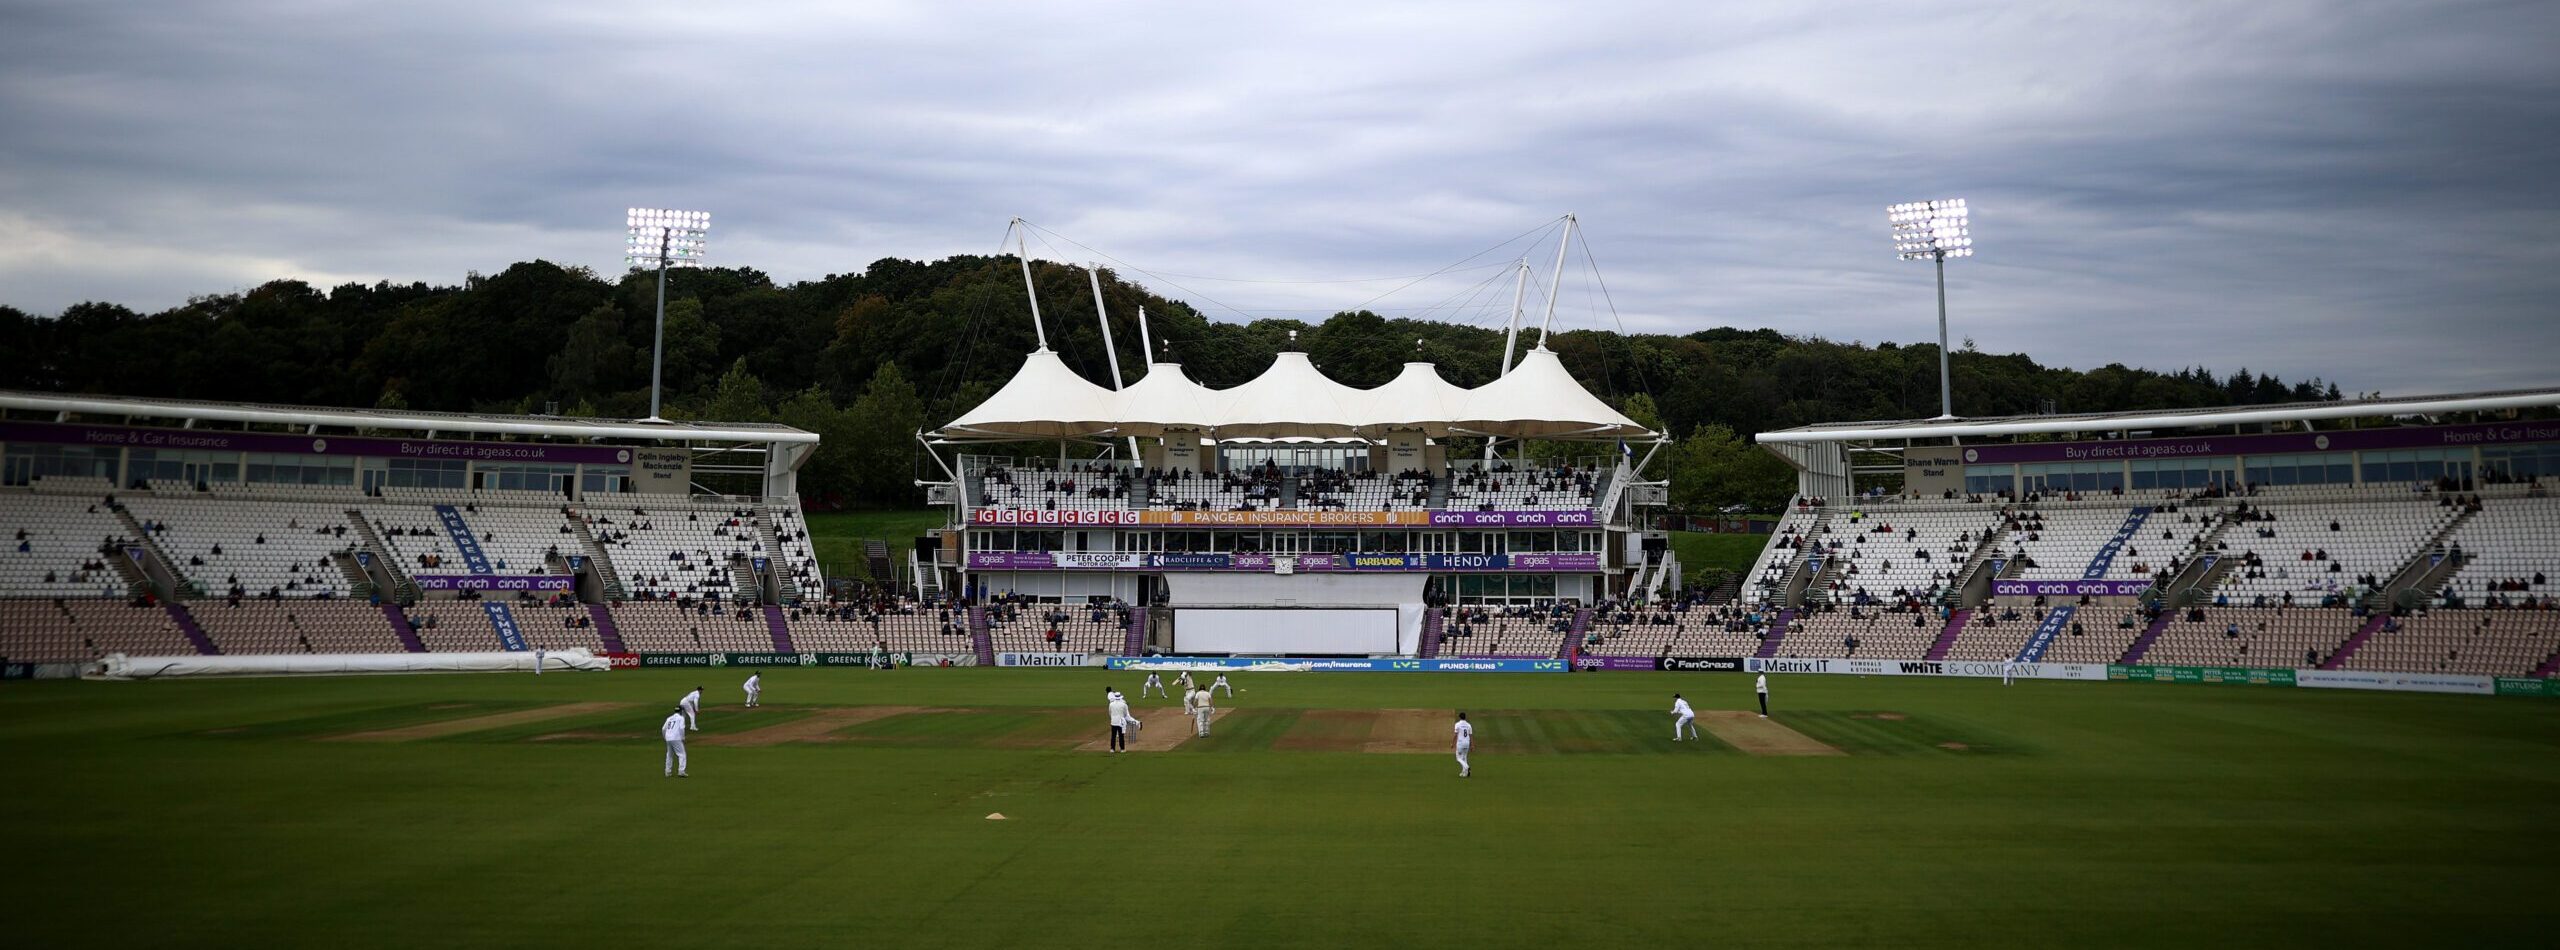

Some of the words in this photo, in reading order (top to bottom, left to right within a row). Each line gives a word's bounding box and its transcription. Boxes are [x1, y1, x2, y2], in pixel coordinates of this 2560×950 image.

[87, 431, 125, 443] Home
[128, 432, 139, 444] &
[144, 433, 164, 445] Car
[168, 434, 229, 448] Insurance
[2443, 431, 2482, 443] Home
[2486, 430, 2497, 440] &
[2501, 429, 2522, 440] Car
[401, 443, 422, 457] Buy
[426, 444, 459, 456] direct
[463, 447, 474, 456] at
[477, 447, 545, 460] ageas.co.uk
[2066, 446, 2088, 460] Buy
[2091, 444, 2124, 457] direct
[2127, 446, 2140, 456] at
[2143, 441, 2211, 458] ageas.co.uk
[643, 462, 682, 470] Mackenzie
[1907, 458, 1931, 467] Shane
[1933, 458, 1959, 466] Warne
[979, 511, 993, 523] IG
[999, 511, 1013, 523] IG
[1019, 511, 1034, 523] IG
[1040, 511, 1054, 523] IG
[1061, 511, 1075, 523] IG
[1081, 511, 1095, 523] IG
[1102, 511, 1116, 523] IG
[1122, 511, 1136, 523] IG
[1195, 513, 1244, 522] PANGEA
[1249, 513, 1315, 522] INSURANCE
[1320, 513, 1374, 522] BROKERS
[1435, 511, 1464, 523] cinch
[1475, 511, 1505, 523] cinch
[1516, 511, 1545, 523] cinch
[1557, 511, 1587, 523] cinch
[979, 556, 1005, 566] ageas
[1239, 556, 1263, 567] ageas
[1303, 556, 1328, 567] ageas
[1355, 557, 1403, 566] BARBADOS
[1443, 556, 1492, 567] HENDY
[1524, 557, 1549, 567] ageas
[416, 577, 448, 589] cinch
[457, 577, 489, 589] cinch
[498, 577, 529, 589] cinch
[538, 577, 570, 589] cinch
[1997, 582, 2029, 594] cinch
[2037, 582, 2069, 594] cinch
[2077, 582, 2109, 594] cinch
[609, 657, 637, 666] ance
[709, 653, 727, 666] IPA
[800, 653, 817, 666] IPA
[828, 656, 861, 664] GREENE
[865, 656, 888, 664] KNG
[890, 653, 908, 664] IPA
[1020, 654, 1065, 665] Matrix
[1071, 654, 1083, 665] IT
[1577, 658, 1604, 669] ageas
[1678, 660, 1735, 669] FanCraze
[1765, 660, 1811, 672] Matrix
[1817, 660, 1829, 672] IT
[1949, 663, 1958, 674] &
